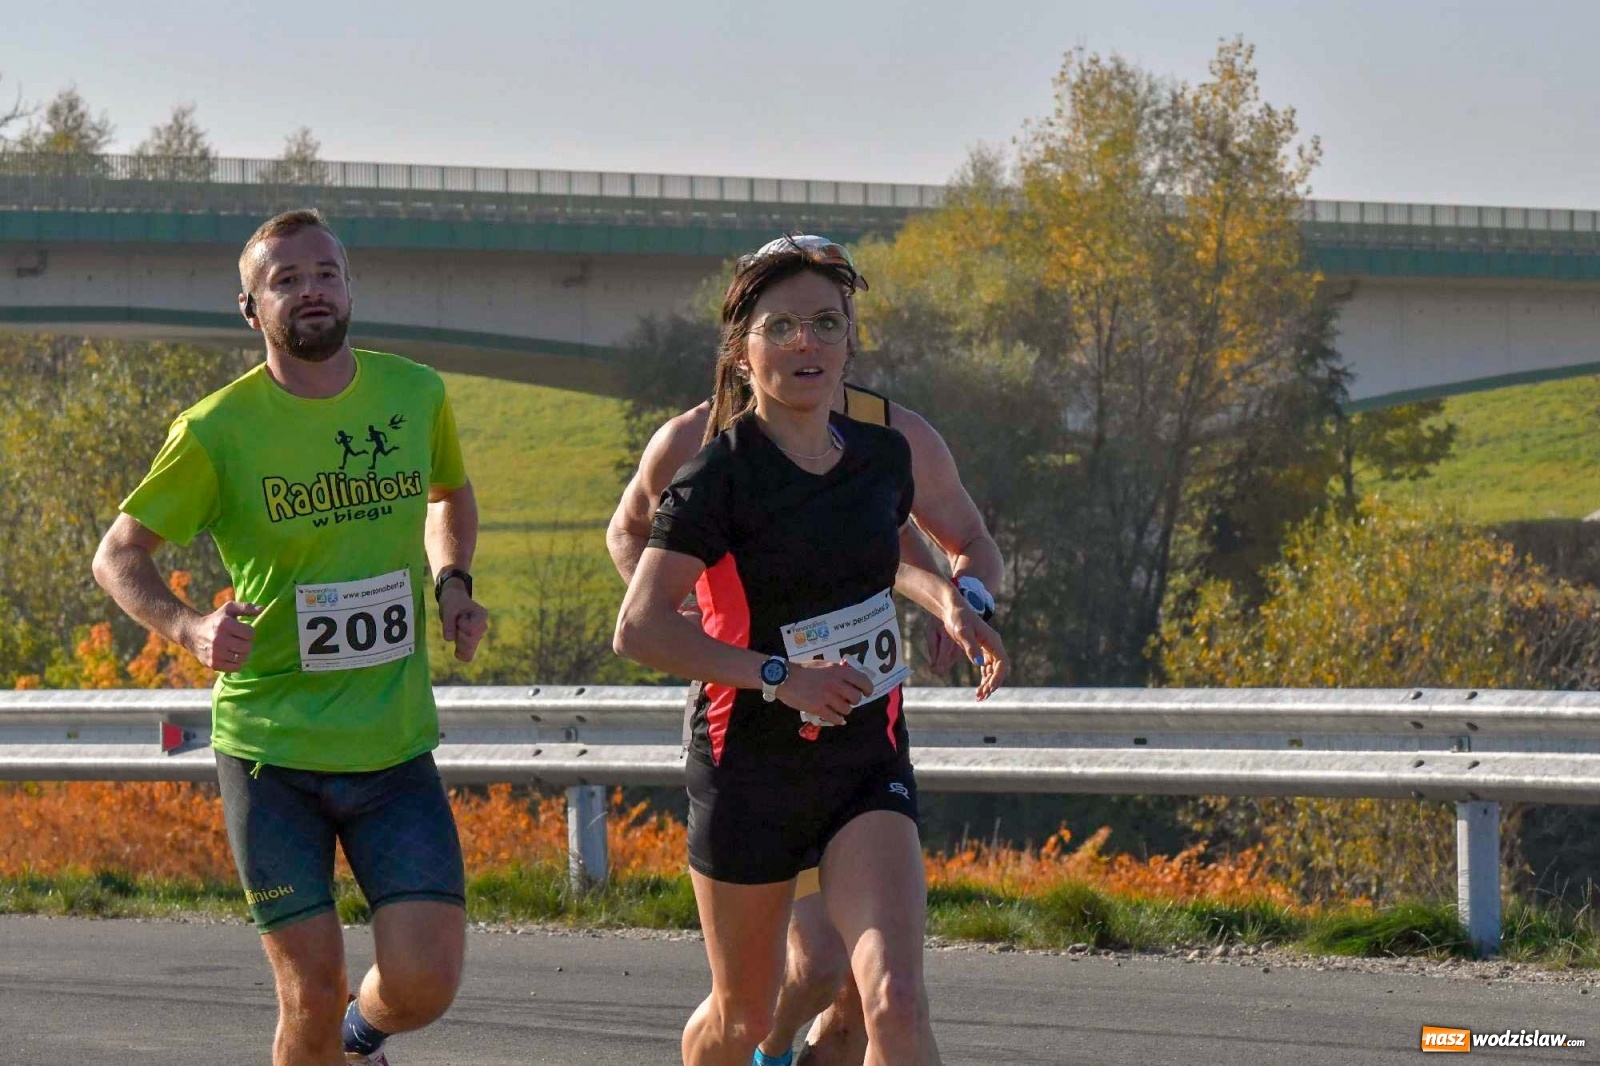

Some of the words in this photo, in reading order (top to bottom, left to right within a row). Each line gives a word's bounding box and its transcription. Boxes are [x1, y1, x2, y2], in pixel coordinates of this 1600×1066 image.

[263, 471, 422, 522] Radlinioki
[312, 516, 329, 528] w
[335, 505, 392, 524] biegu
[306, 604, 408, 654] 208
[813, 629, 896, 674] 79
